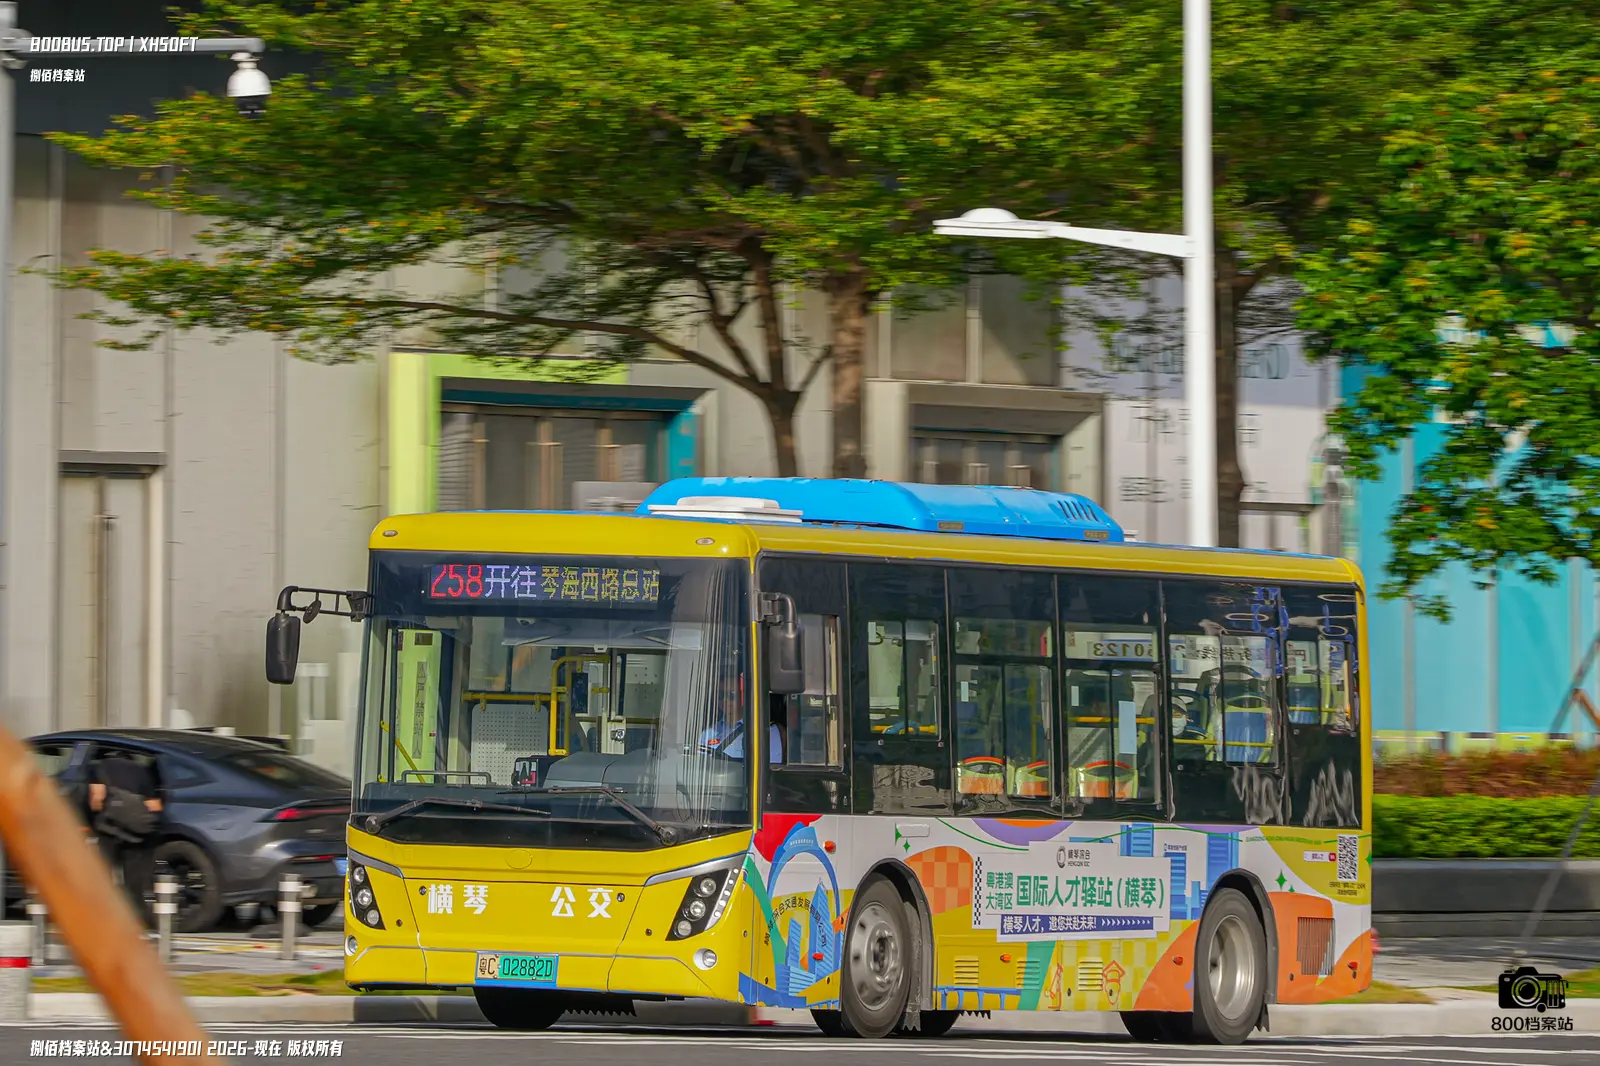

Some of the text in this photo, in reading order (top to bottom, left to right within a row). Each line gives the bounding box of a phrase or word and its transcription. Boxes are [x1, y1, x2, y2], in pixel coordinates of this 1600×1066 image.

[431, 564, 484, 598] 258
[986, 871, 1014, 889] 粤港澳
[427, 884, 613, 918] 横琴 公交
[986, 892, 1013, 910] 大湾区
[502, 958, 553, 977] 02882D
